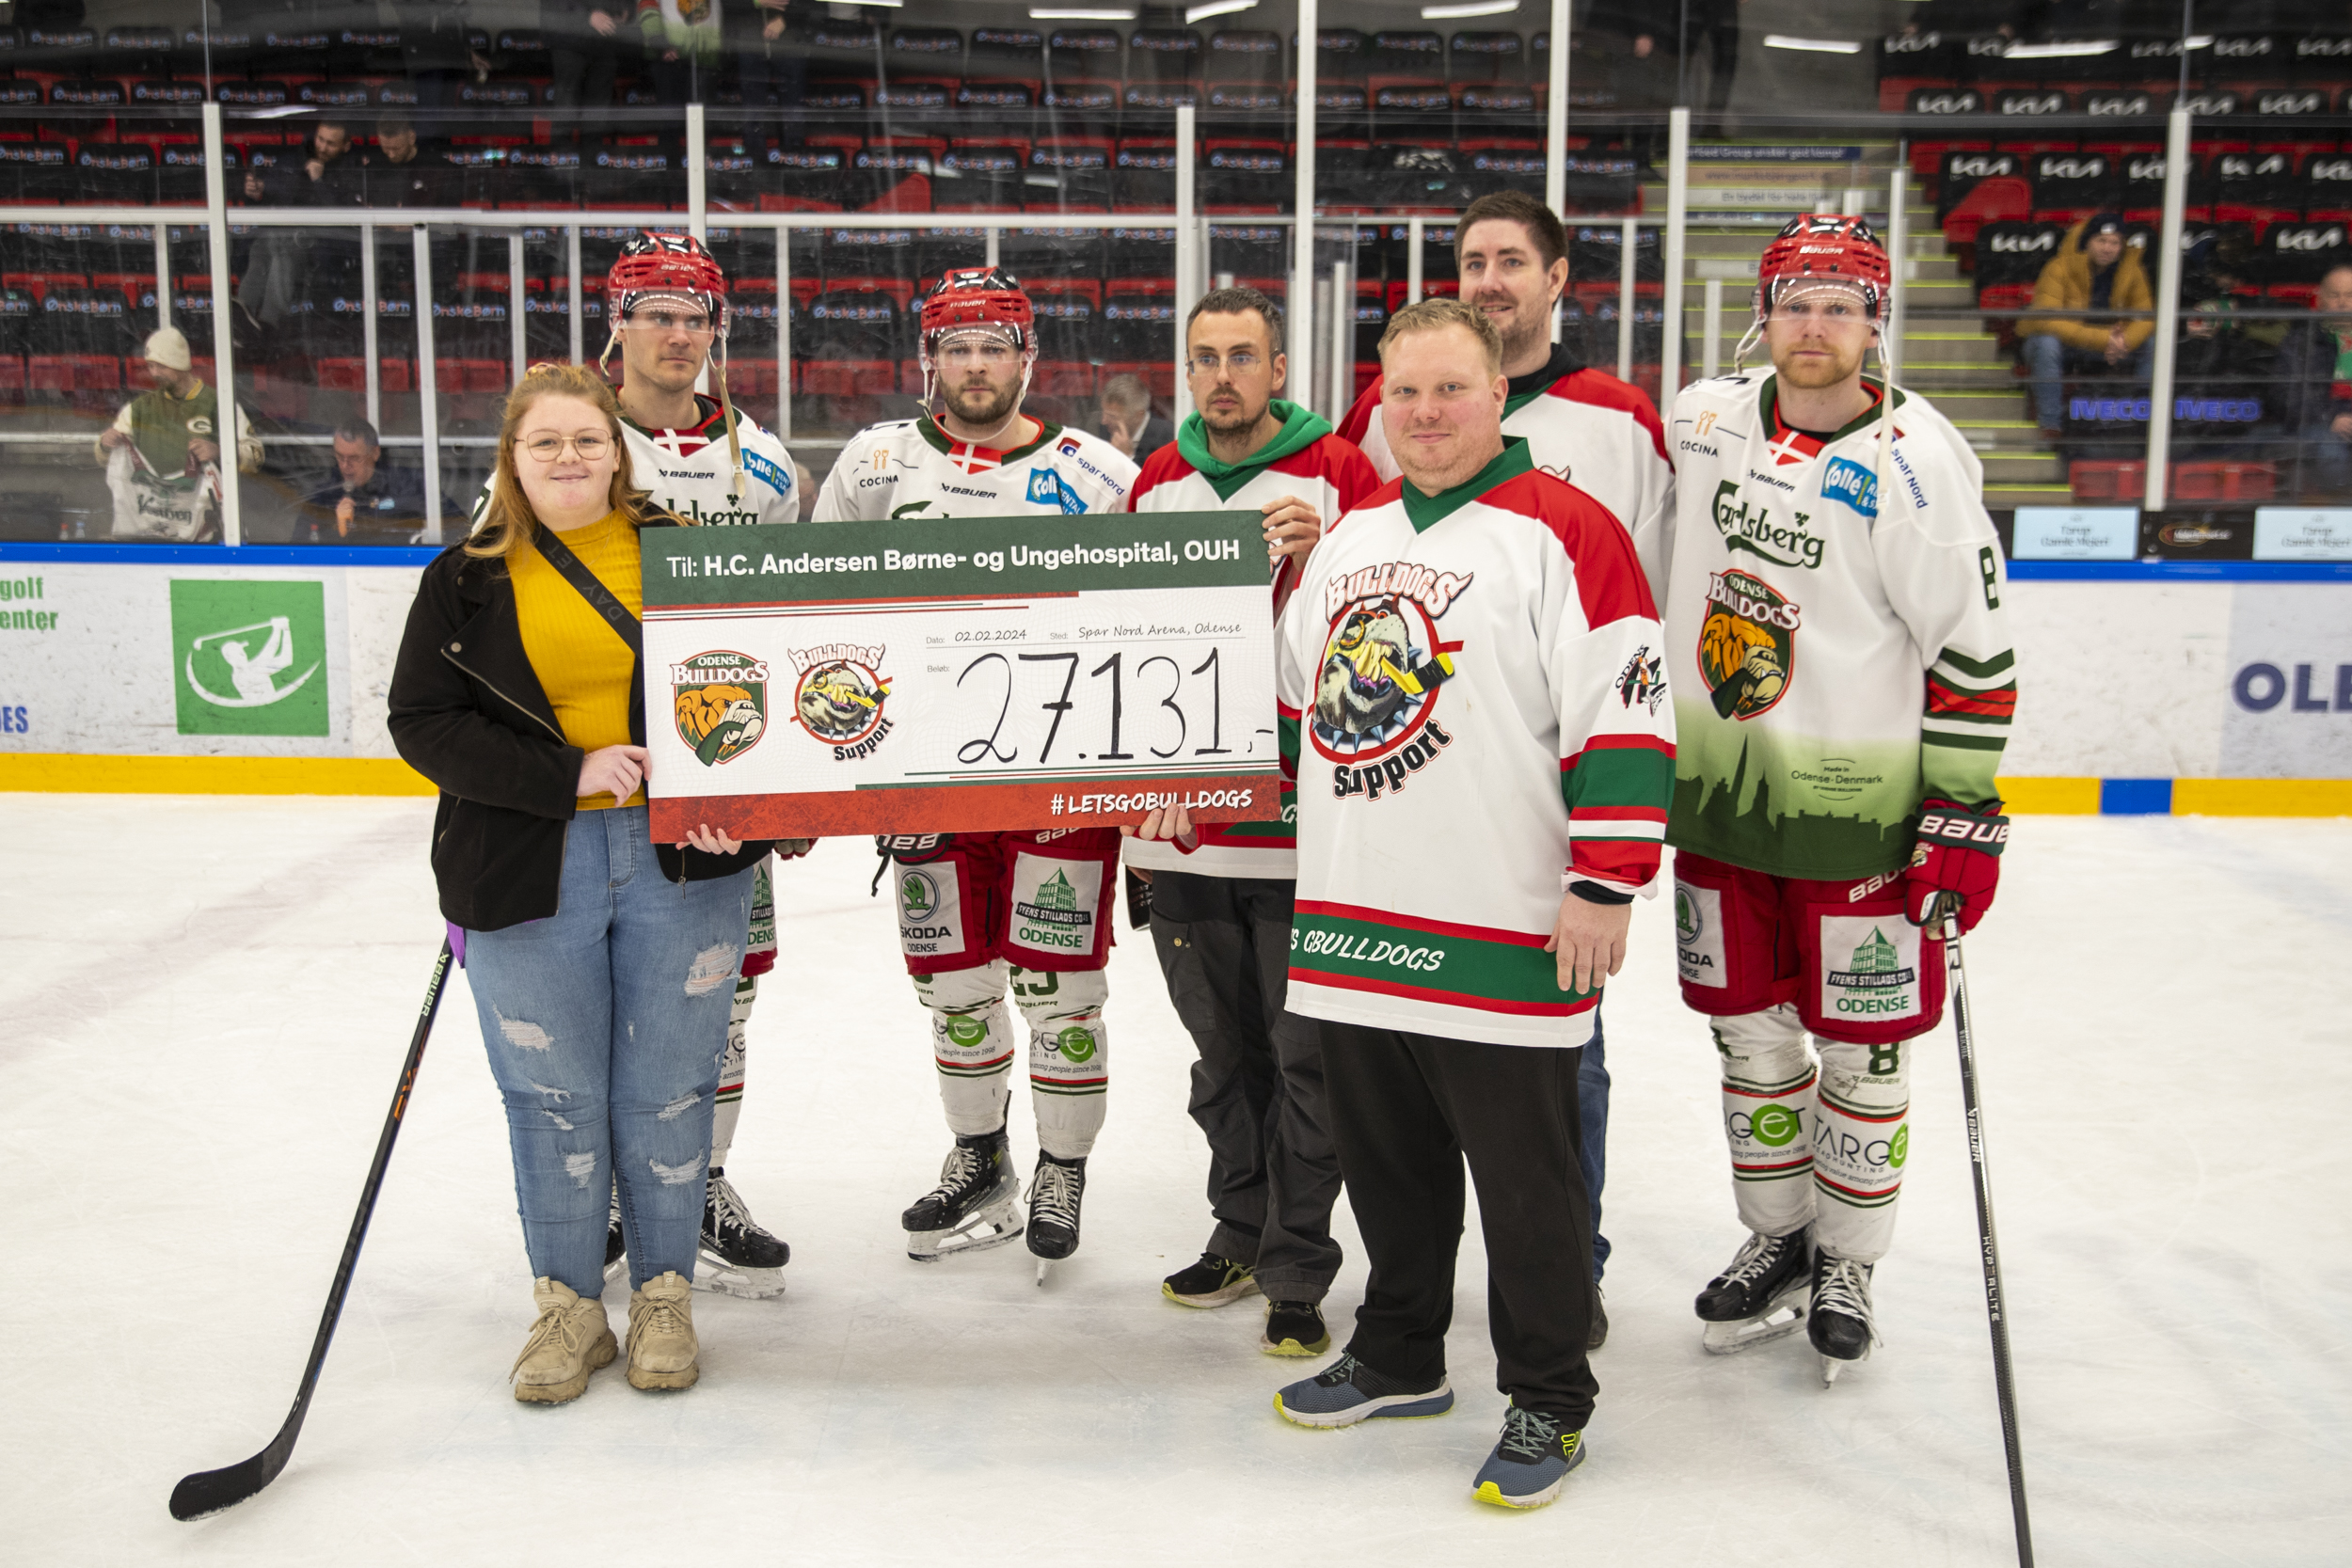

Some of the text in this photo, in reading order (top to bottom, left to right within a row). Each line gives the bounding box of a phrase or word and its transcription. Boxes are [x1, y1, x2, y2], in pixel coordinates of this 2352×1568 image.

[54, 86, 119, 103] ØnskeBørn
[135, 86, 202, 101] ØnskeBørn
[80, 151, 149, 169] ØnskeBørn
[19, 223, 90, 236] ØnskeBørn
[837, 231, 910, 244] ØnskeBørn
[46, 297, 122, 312] ØnskeBørn
[814, 305, 891, 320] ØnskeBørn
[2070, 397, 2152, 421] IVECO
[2173, 397, 2262, 422] IVECO
[1679, 439, 1719, 458] COCINA
[1076, 456, 1103, 478] spar
[1891, 448, 1914, 476] spar
[669, 470, 715, 480] BAUER
[859, 474, 899, 488] COCINA
[1756, 472, 1795, 493] BAUER
[950, 486, 997, 499] BAUER
[1033, 474, 1057, 497] Coll
[1711, 480, 1825, 570] Carlsberg
[666, 539, 1240, 578] Til: H.C. Andersen Børne- og Ungehospital, OUH
[1326, 561, 1474, 623] BULLDOGS
[1728, 574, 1770, 600] ODENSE
[1707, 572, 1801, 632] BULLDOGS
[926, 629, 1027, 644] Dato: 02.02.2024
[1050, 623, 1242, 641] Sted: Spar Nord Arena, Odense
[697, 655, 741, 667] ODENSE
[787, 643, 886, 676] BULLDOGS
[927, 664, 950, 673] Beløb:
[670, 660, 770, 685] BULLDOGS
[834, 716, 895, 763] Support
[1332, 718, 1454, 802] Support
[1916, 815, 2010, 843] BAUE
[1018, 904, 1040, 917] FYENS
[1040, 910, 1073, 923] STILLADS
[907, 942, 939, 952] ODENSE
[1019, 927, 1084, 949] ODENSE
[421, 961, 445, 1017] BAUER
[1858, 974, 1897, 986] STILLADS
[1836, 994, 1910, 1014] ODENSE
[961, 1049, 980, 1057] since
[981, 1046, 996, 1054] 1998
[1868, 1042, 1899, 1076] 8
[1072, 1065, 1089, 1073] since
[1967, 1117, 1981, 1164] BAUER
